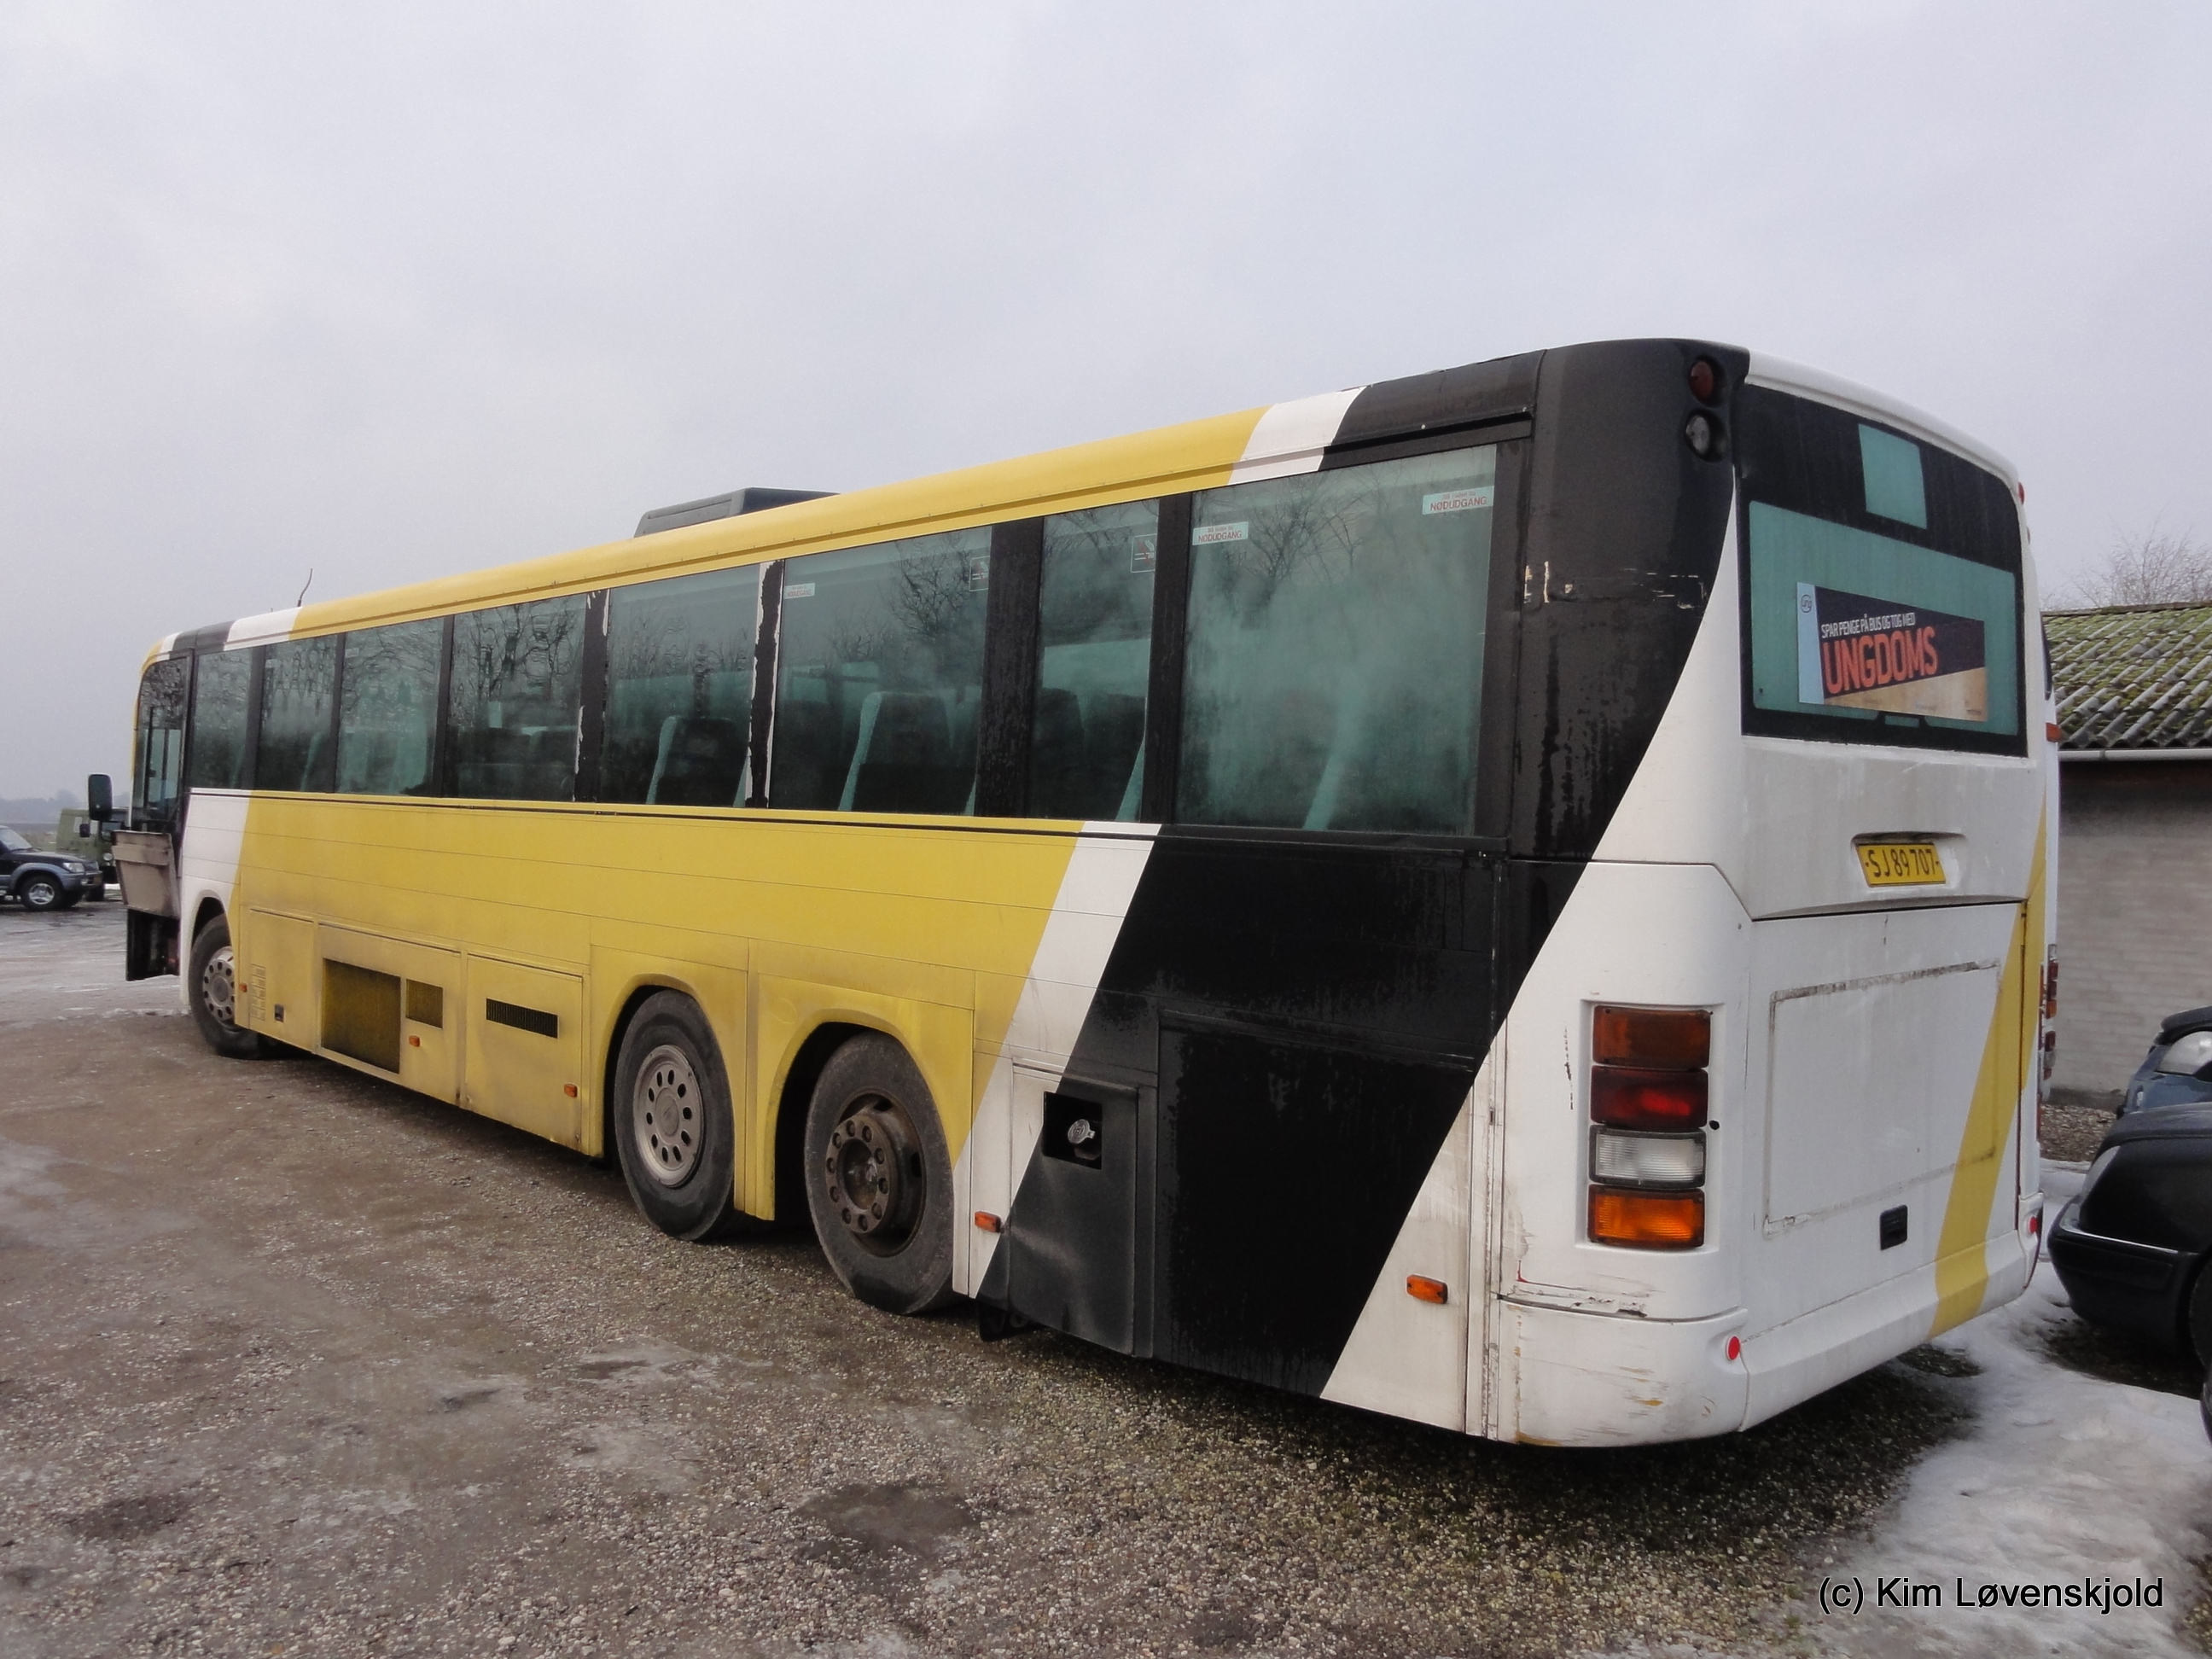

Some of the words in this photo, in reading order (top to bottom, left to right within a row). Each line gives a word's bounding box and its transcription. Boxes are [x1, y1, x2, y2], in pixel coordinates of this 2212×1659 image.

[1430, 496, 1487, 510] NØDUDGANG
[1821, 624, 1840, 638] SPAR
[1839, 619, 1860, 636] PENGE
[1860, 614, 1870, 632] PÅ
[1869, 616, 1881, 631] BUS
[1881, 615, 1890, 629] OG
[1890, 614, 1902, 628] TOG
[1902, 612, 1916, 626] MED
[1823, 626, 1939, 694] UNGDOMS
